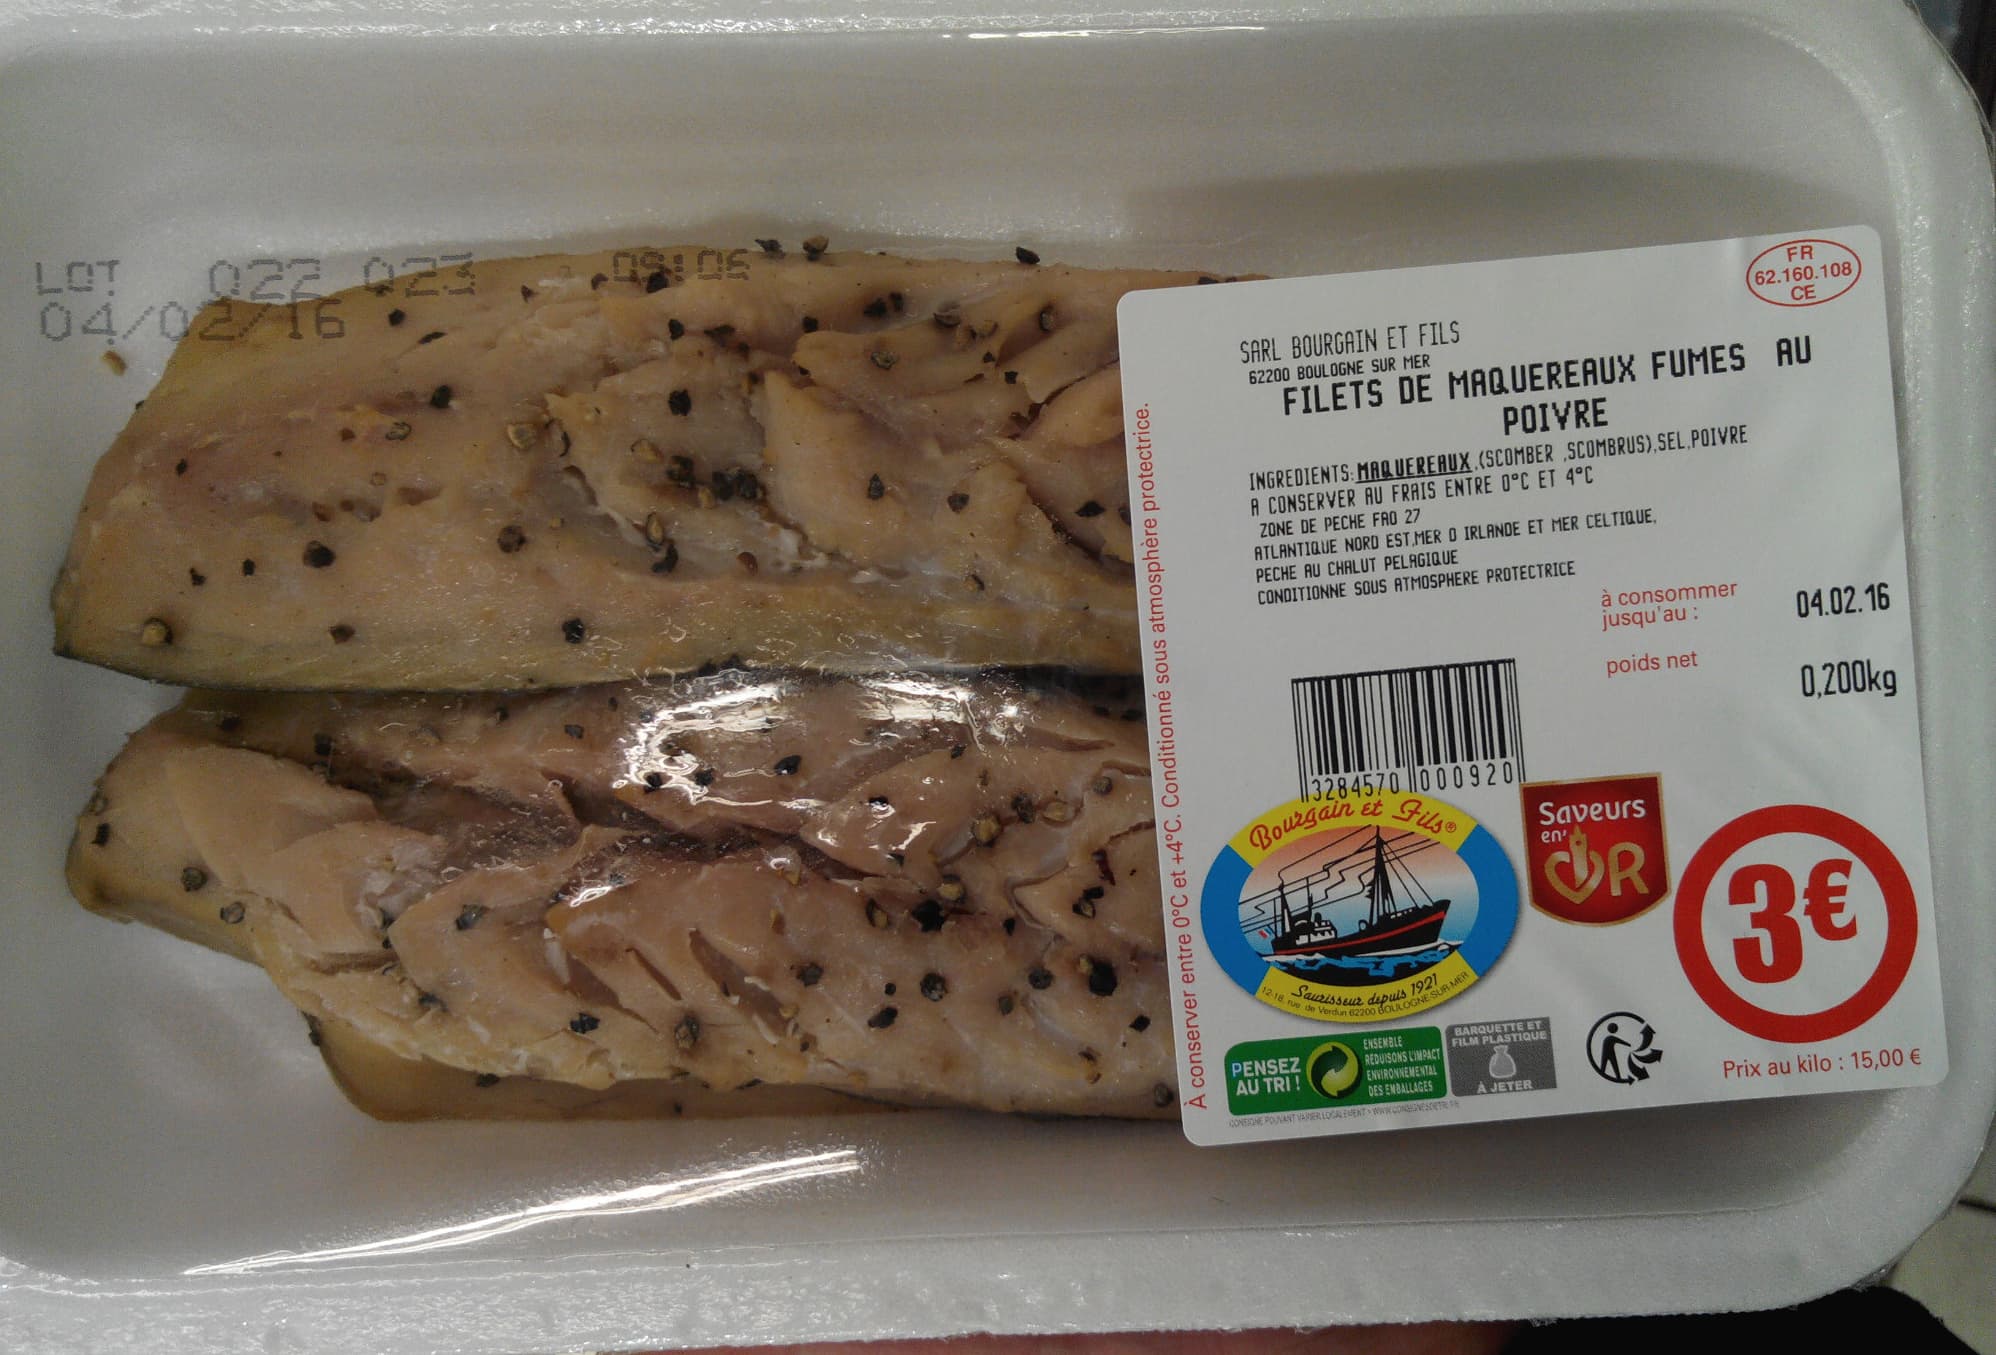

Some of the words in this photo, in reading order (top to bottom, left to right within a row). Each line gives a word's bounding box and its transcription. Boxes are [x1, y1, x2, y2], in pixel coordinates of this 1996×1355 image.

[1787, 245, 1813, 262] FR
[36, 260, 120, 296] LOT
[209, 258, 320, 300] 022
[364, 252, 475, 297] 023
[1755, 261, 1852, 285] 62.160.108
[1790, 284, 1816, 301] CE
[40, 301, 345, 345] 04/02/16
[1240, 338, 1281, 363] SARL
[1292, 328, 1377, 359] BOURGAIN
[1387, 325, 1408, 350] ET
[1419, 320, 1460, 346] FILS
[1249, 367, 1290, 384] 62200
[1297, 360, 1364, 380] BOULOGNE
[1371, 357, 1396, 373] SUR
[1403, 354, 1430, 370] MER
[1283, 378, 1383, 415] FILETS
[1399, 373, 1433, 404] DE
[1448, 354, 1636, 400] MAQUEREAUX
[1651, 343, 1746, 379] FUMES
[1776, 335, 1811, 366] AU
[1503, 397, 1608, 435] POIVRE
[1132, 403, 1160, 512] protectrice.
[1251, 498, 1259, 516] A
[1268, 489, 1355, 514] CONSERVER
[1365, 486, 1383, 505] AU
[1392, 482, 1436, 502] FRAIS
[1445, 476, 1491, 498] ENTRE
[1538, 469, 1555, 488] ET
[1566, 466, 1594, 485] 4°C
[1260, 521, 1293, 537] ZONE
[1301, 519, 1317, 534] DE
[1324, 514, 1365, 532] PECHE
[1373, 511, 1397, 527] FAO
[1404, 508, 1421, 524] 27
[1254, 539, 1337, 560] ATLANTIQUE
[1345, 535, 1379, 552] NORD
[1465, 520, 1520, 540] IRLANDE
[1528, 519, 1544, 535] ET
[1551, 516, 1579, 532] MER
[1139, 518, 1166, 633] atmosphère
[1256, 564, 1296, 583] PECHE
[1304, 562, 1321, 578] AU
[1328, 557, 1376, 576] CHALUT
[1384, 549, 1459, 571] PELAGIQUE
[1258, 583, 1347, 605] CONDITIONNE
[1354, 580, 1387, 596] SOUS
[1395, 571, 1479, 593] ATMOSPHERE
[1486, 561, 1576, 583] PROTECTRICE
[1601, 589, 1612, 607] à
[1618, 583, 1737, 606] consommer
[1796, 582, 1890, 617] 04.02.16
[1153, 639, 1170, 684] sous
[1607, 653, 1660, 677] poids
[1667, 651, 1698, 668] net
[1801, 659, 1898, 699] 0,200kg
[1152, 690, 1180, 807] Conditionné
[1311, 772, 1399, 802] 3284570
[1421, 761, 1513, 792] 000920
[1249, 800, 1354, 851] Bourgain
[1361, 799, 1383, 816] et
[1539, 799, 1646, 826] Saveurs
[1170, 870, 1187, 888] et
[1177, 933, 1195, 984] entre
[1318, 1005, 1347, 1017] Verdun
[1367, 990, 1407, 1010] depuis
[1183, 991, 1205, 1088] conserver
[1363, 1036, 1403, 1050] ENSEMBLE
[1451, 1036, 1479, 1047] FILM
[1482, 1030, 1547, 1045] PLASTIQUE
[1454, 1022, 1523, 1037] BARQUETTE
[1527, 1020, 1542, 1030] ET
[1231, 1057, 1301, 1078] PENSEZ
[1366, 1064, 1437, 1081] ENVIRONNEMENTAL
[1723, 1059, 1761, 1078] Prix
[1768, 1062, 1791, 1076] au
[1797, 1054, 1832, 1074] kilo
[1236, 1078, 1260, 1096] AU
[1263, 1077, 1292, 1094] TRI
[1368, 1085, 1384, 1097] DES
[1385, 1080, 1433, 1096] EMBALLAGES
[1489, 1080, 1533, 1092] JETER
[1184, 1094, 1207, 1110] À
